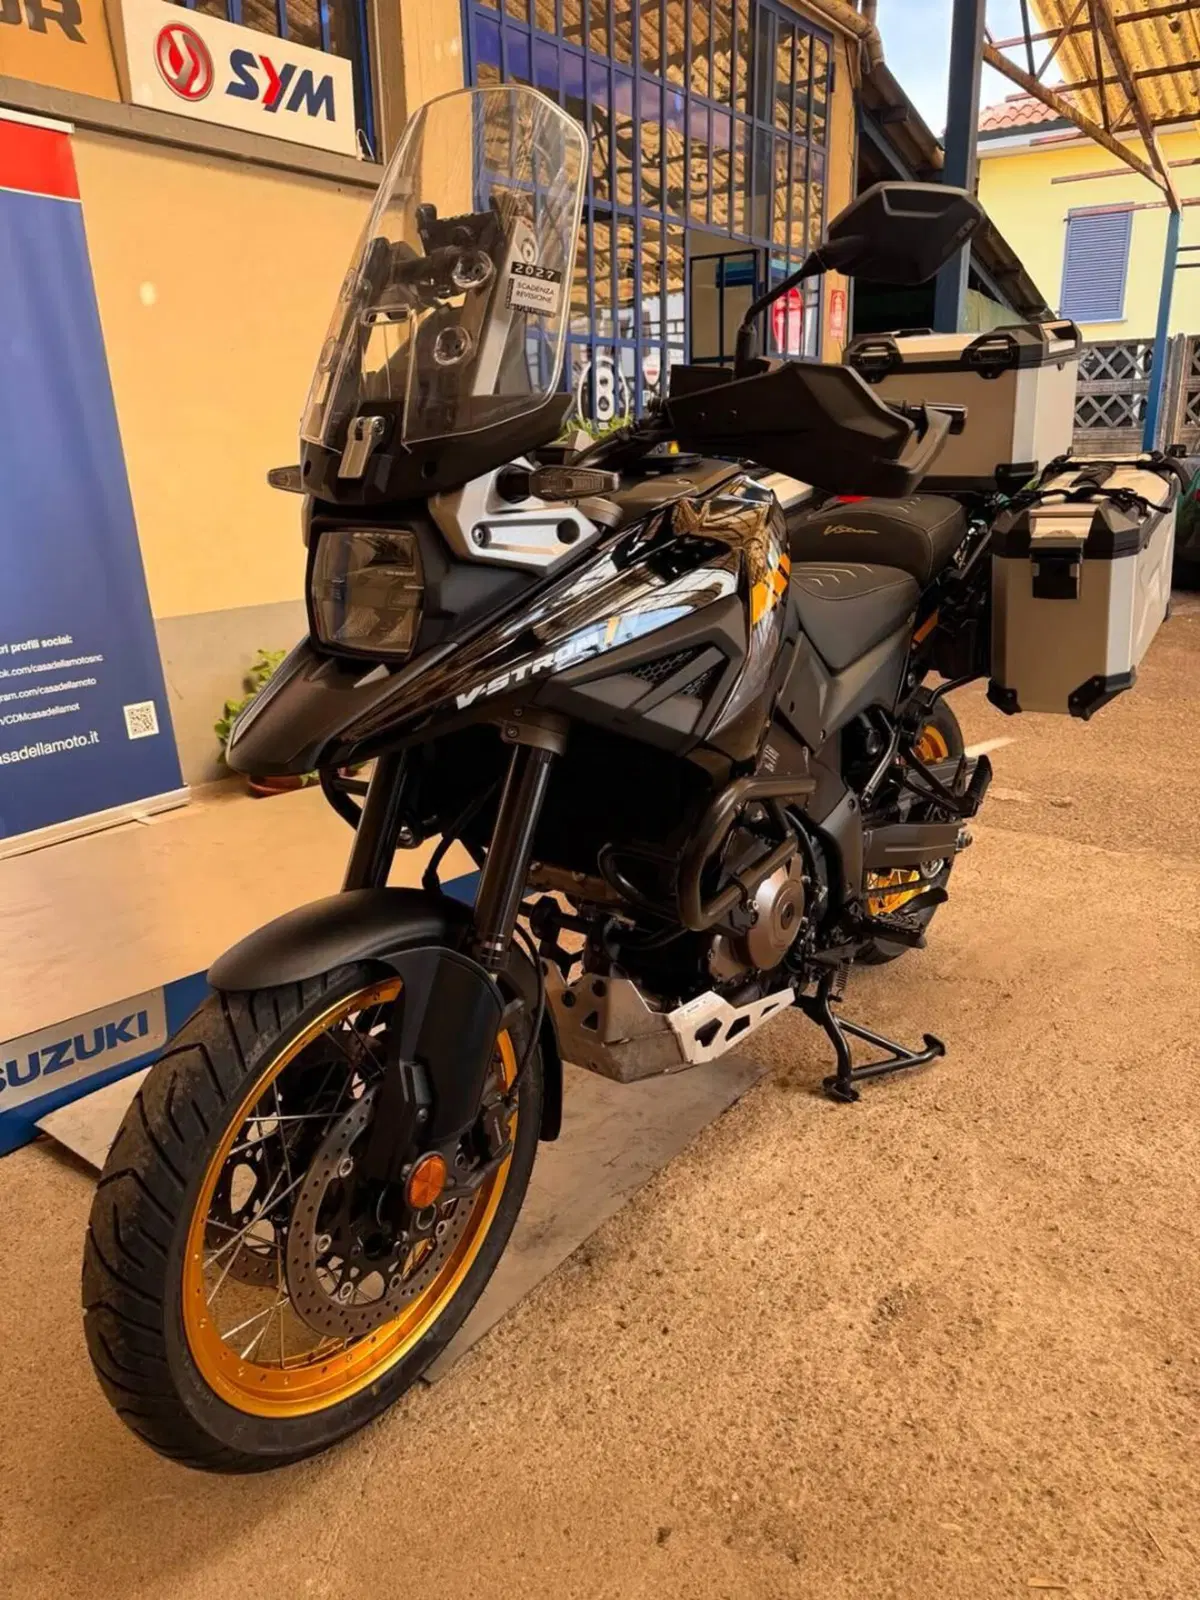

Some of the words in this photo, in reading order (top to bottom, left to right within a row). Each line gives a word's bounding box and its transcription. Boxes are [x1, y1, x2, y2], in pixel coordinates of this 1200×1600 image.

[225, 49, 336, 122] SYM
[514, 264, 555, 280] 2027
[516, 290, 553, 304] REVISIONE
[517, 281, 555, 296] SCADENZA
[11, 638, 40, 654] profili
[41, 634, 73, 648] social:
[456, 632, 600, 710] V-STROM
[0, 677, 97, 703] ram.com/casadellamoto
[0, 703, 80, 726] /CDMcasadellamot
[0, 1010, 149, 1094] UZUKI
